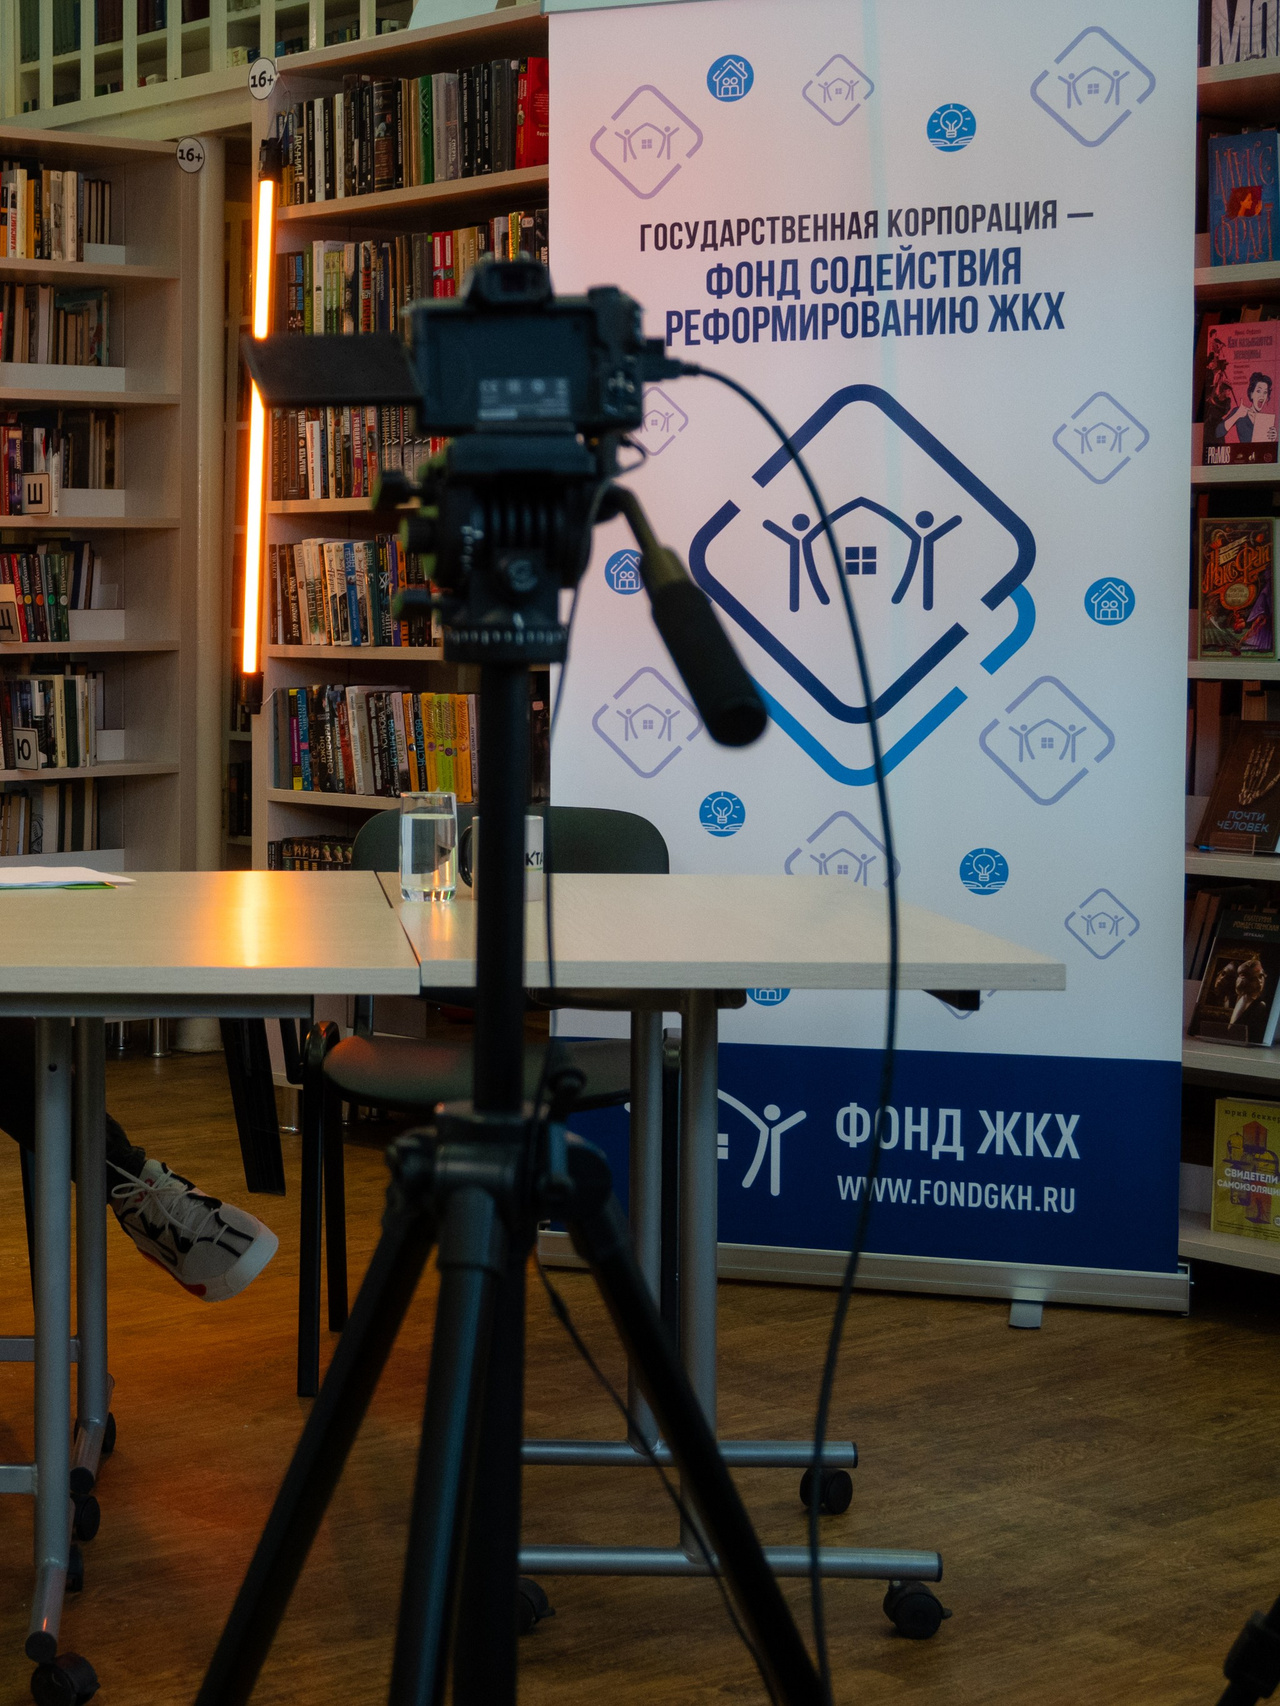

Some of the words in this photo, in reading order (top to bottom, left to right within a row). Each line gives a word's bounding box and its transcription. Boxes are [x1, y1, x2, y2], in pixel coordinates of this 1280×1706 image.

[250, 70, 273, 88] 16+
[178, 147, 203, 162] 16+
[295, 135, 303, 175] АКУНИН
[640, 210, 878, 252] ГОСУДАРСТВЕННАЯ
[887, 199, 1057, 238] КОРПОРАЦИЯ
[706, 259, 800, 300] ФОНД
[810, 245, 1022, 297] СОДЕЙСТВИЯ
[666, 296, 978, 347] РЕФОРМИРОВАНИЮ
[988, 291, 1065, 333] ЖКХ
[306, 579, 316, 618] ПЕННИ
[315, 579, 323, 618] ПЕННИ
[380, 711, 388, 749] УСТИНОВА
[425, 700, 434, 740] Устинова
[457, 701, 467, 740] Устинова
[17, 739, 31, 761] Ю
[324, 724, 334, 774] СЭНДФОРД
[388, 719, 398, 765] УСТИНОВА
[396, 729, 404, 763] КРЕДИТ
[416, 719, 425, 766] УСТИНОВА
[1217, 820, 1269, 833] ЧЕЛОВЕК
[1227, 810, 1266, 822] ПОЧТИ
[835, 1102, 965, 1161] ФОНД
[977, 1109, 1081, 1159] ЖКХ
[837, 1175, 1076, 1213] WWW.FONDGKH.RU
[1224, 1168, 1278, 1184] СВИДЕТЕЛИ
